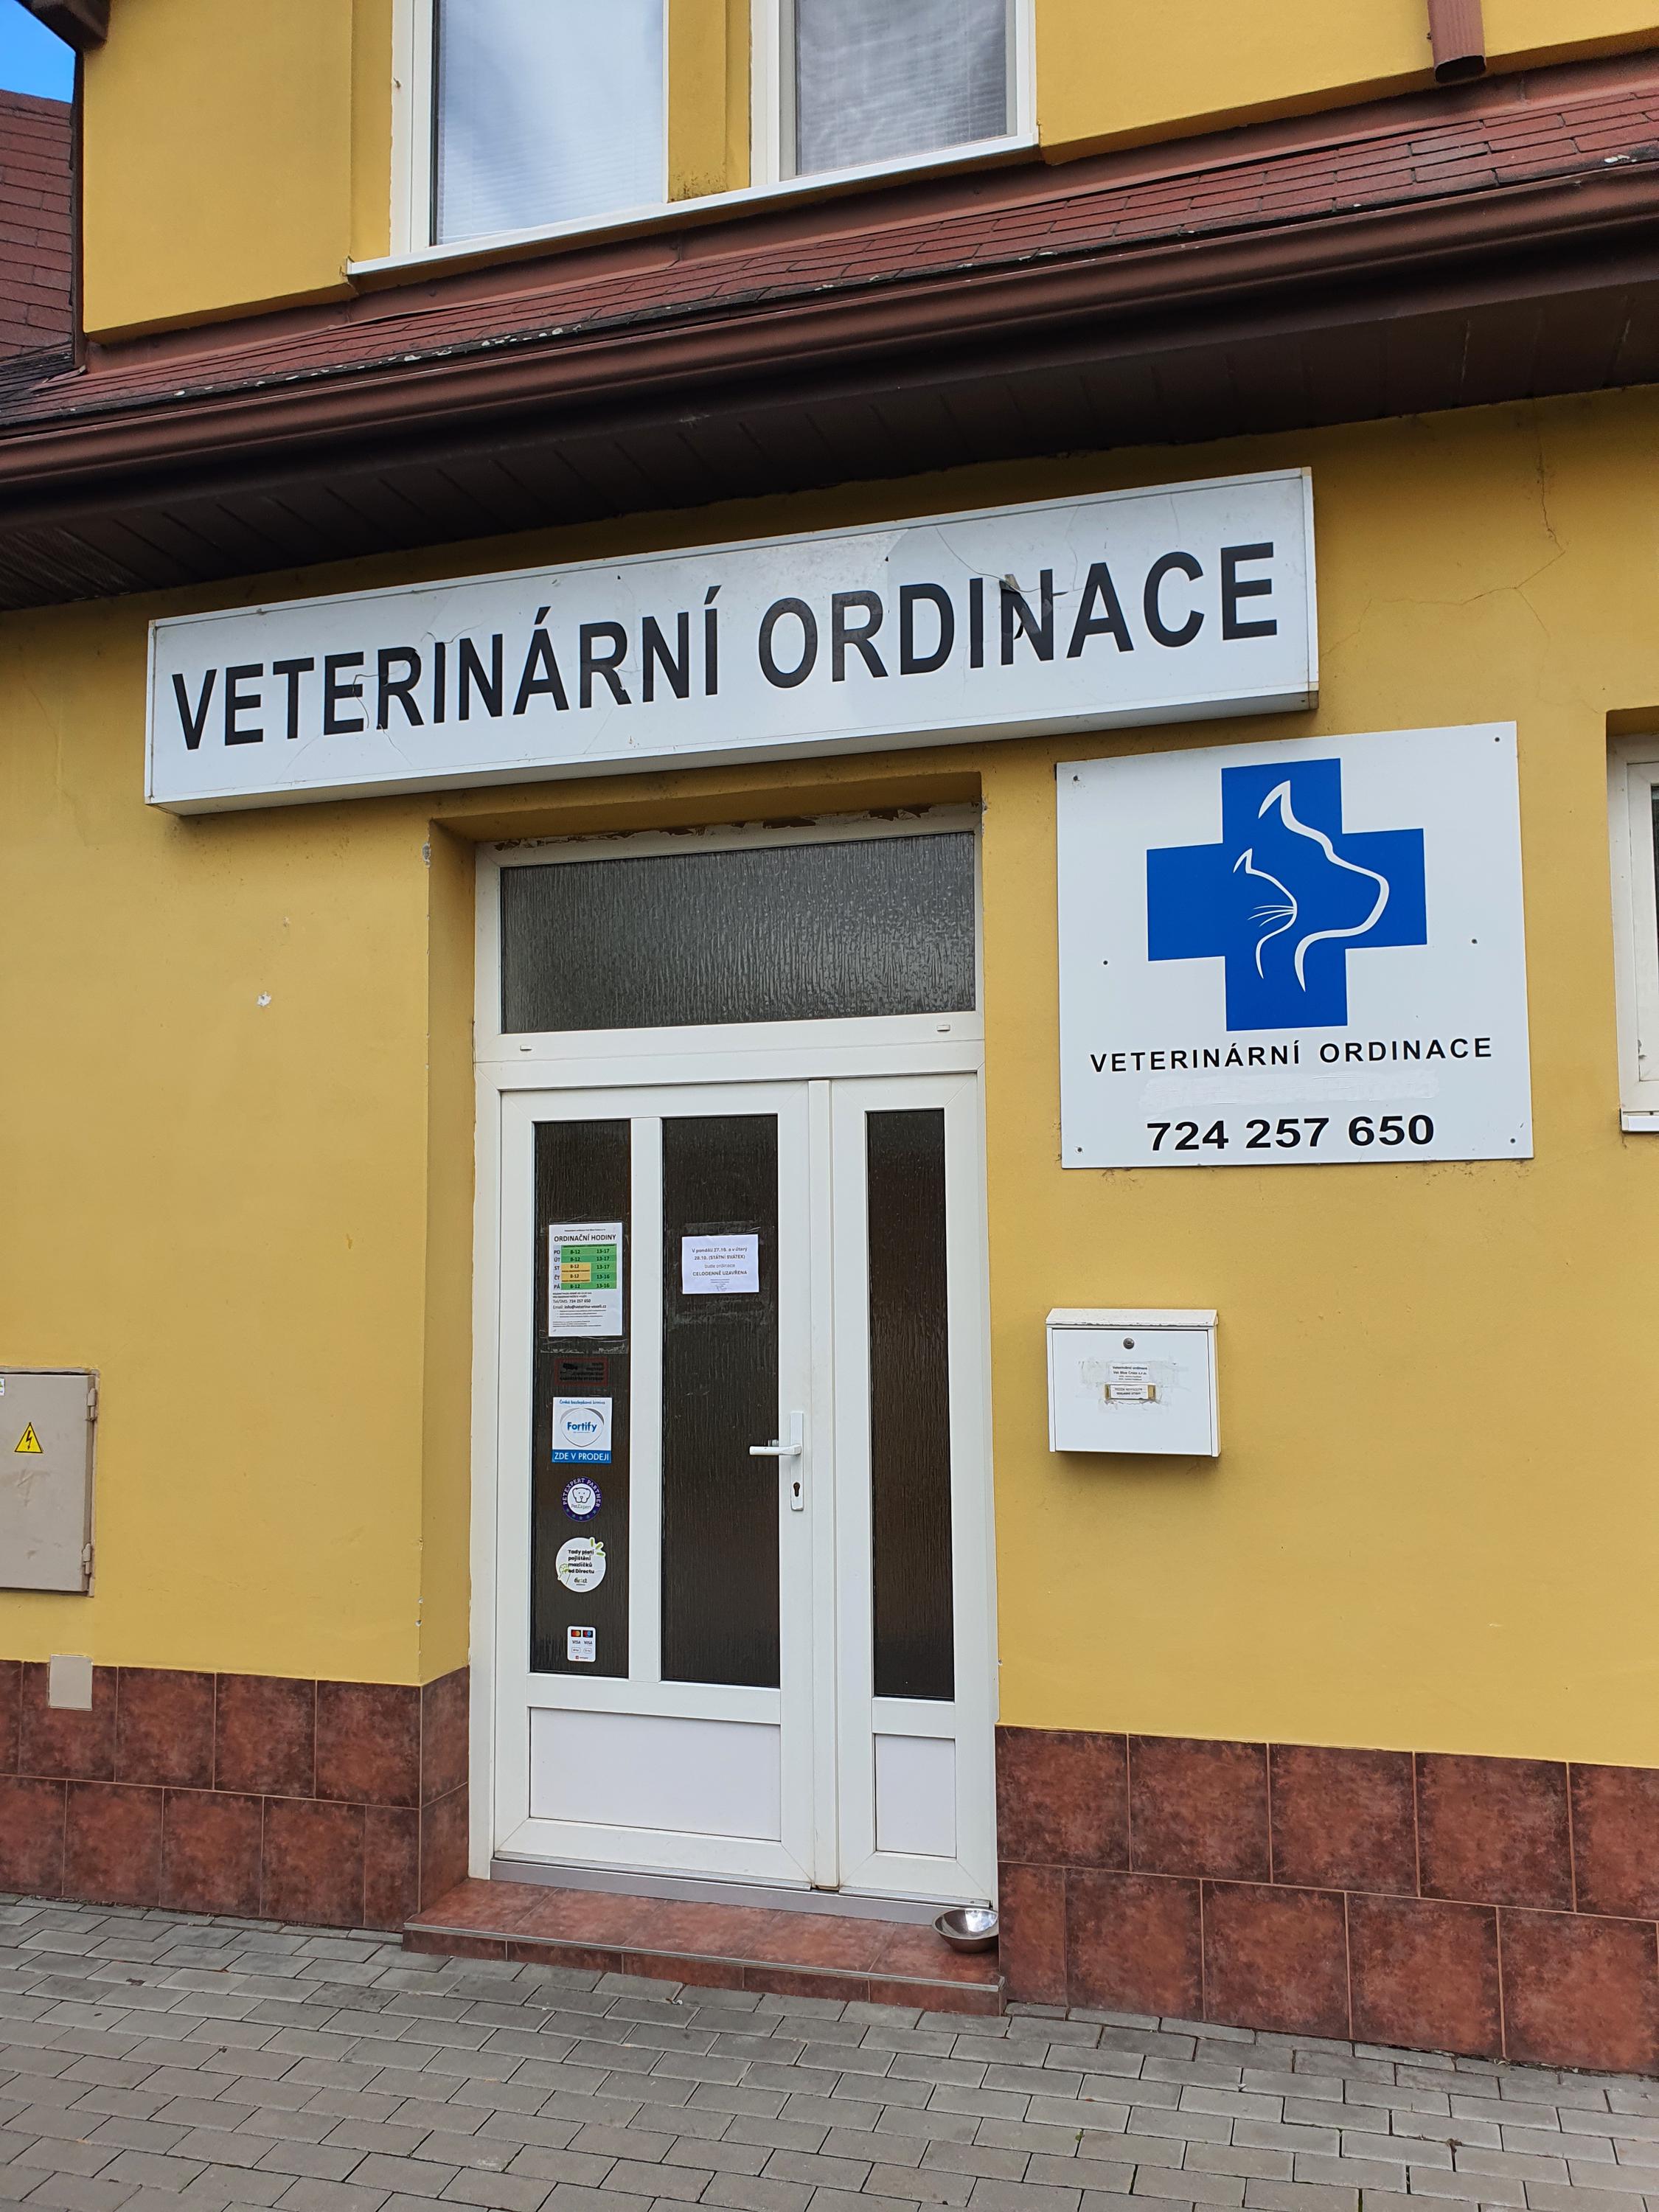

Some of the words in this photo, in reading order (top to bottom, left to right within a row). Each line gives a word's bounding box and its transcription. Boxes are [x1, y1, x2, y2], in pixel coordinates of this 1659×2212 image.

[172, 585, 722, 750] VETERINÁRNÍ
[758, 542, 1278, 688] ORDINACE
[1090, 1040, 1300, 1073] VETERINÁRNÍ
[1319, 1037, 1492, 1064] ORDINACE
[1147, 1120, 1229, 1151] 724
[1245, 1117, 1329, 1149] 257
[1347, 1114, 1435, 1147] 650
[554, 1234, 590, 1242] ORDINAČNÍ
[567, 1422, 597, 1432] Fortify
[554, 1452, 568, 1460] ZDE
[578, 1453, 609, 1461] PRODEJI
[563, 1478, 585, 1505] PETEXPERT
[586, 1479, 601, 1507] PARTNER
